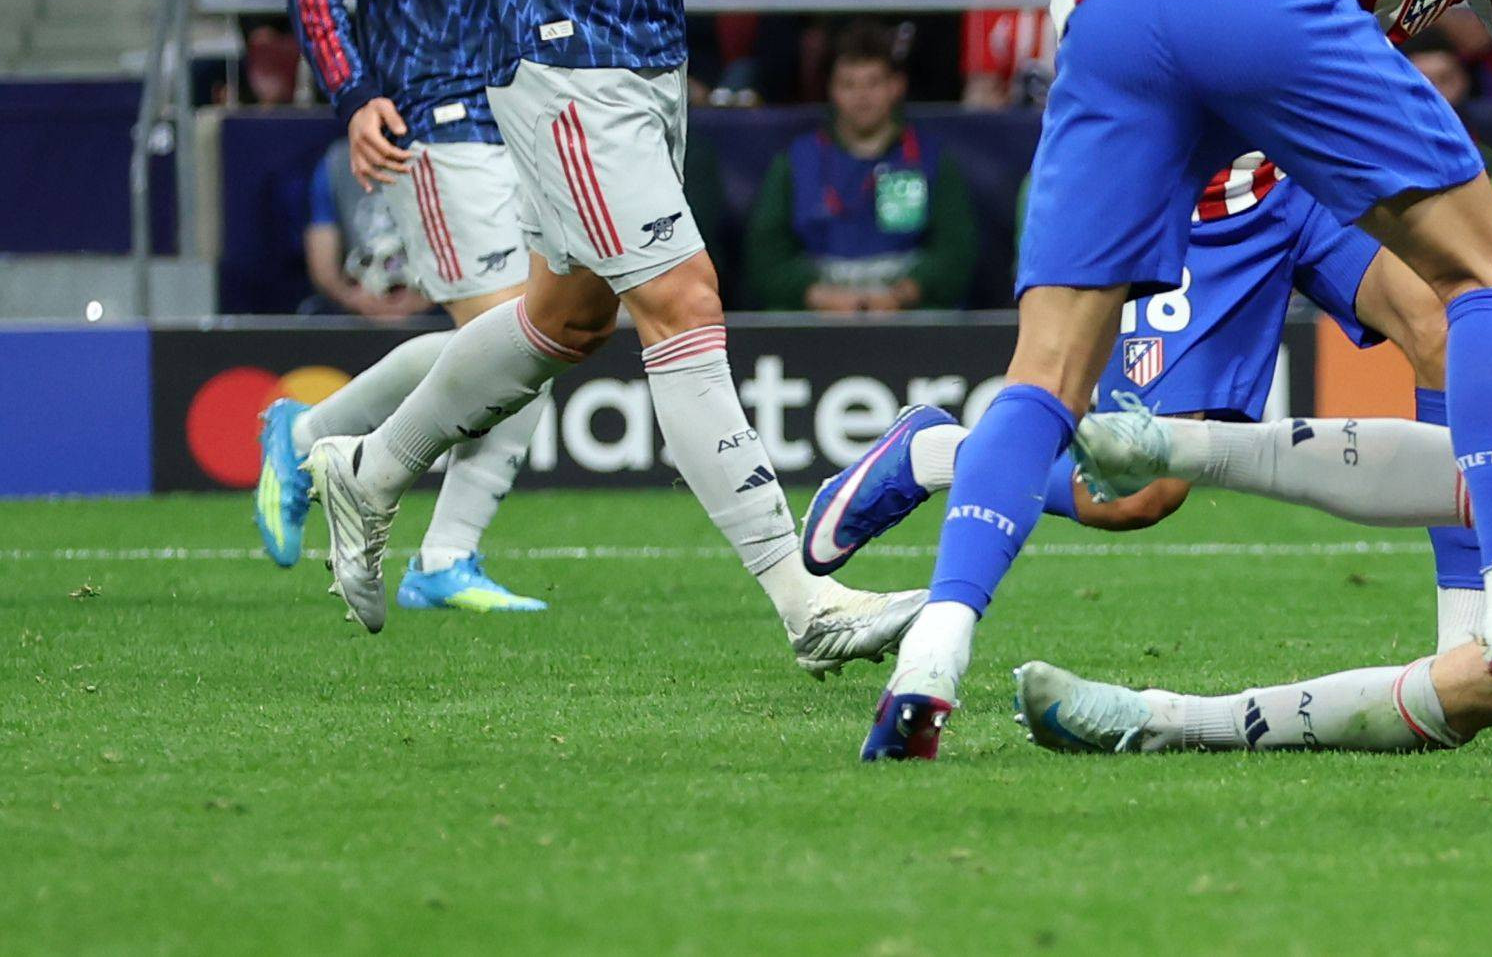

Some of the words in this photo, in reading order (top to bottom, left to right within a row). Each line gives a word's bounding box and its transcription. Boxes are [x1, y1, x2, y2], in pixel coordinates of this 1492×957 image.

[717, 428, 759, 454] AFC
[1342, 418, 1359, 467] AFC
[946, 504, 1015, 536] ATLETI
